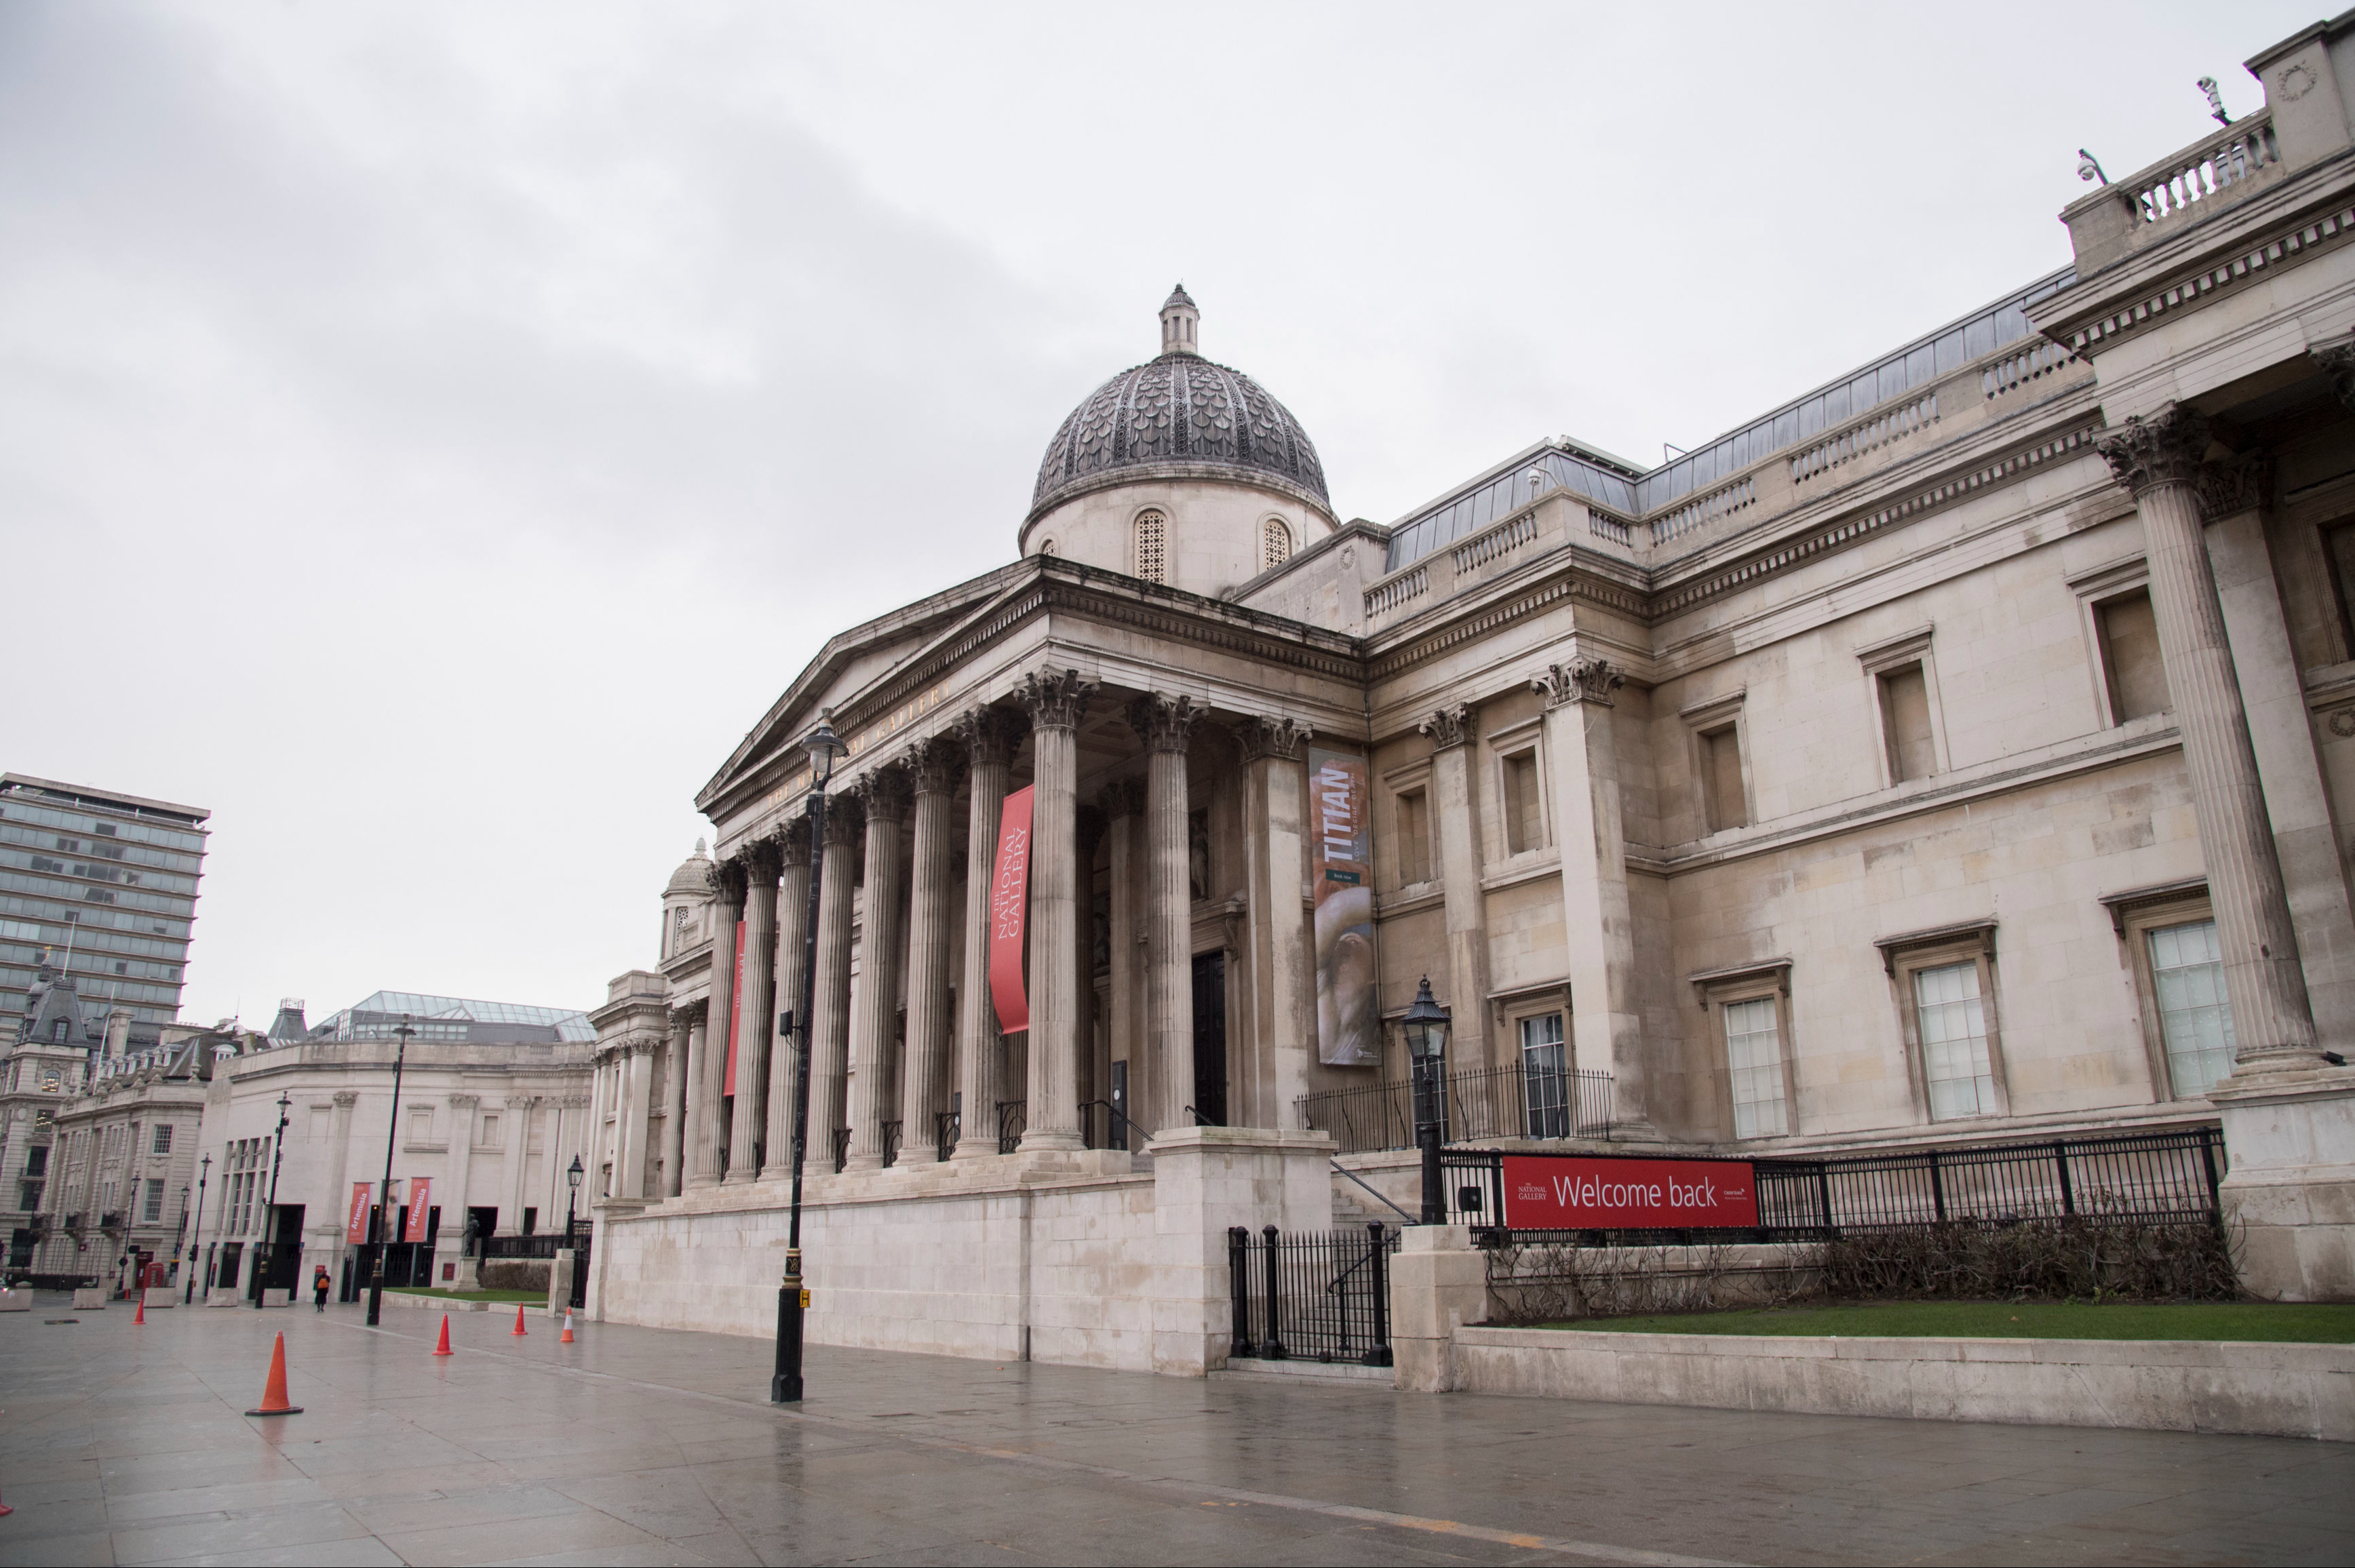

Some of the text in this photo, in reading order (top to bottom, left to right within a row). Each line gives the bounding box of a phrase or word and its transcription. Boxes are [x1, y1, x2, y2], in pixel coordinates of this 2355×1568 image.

[768, 783, 790, 810] THE
[877, 678, 953, 740] GALLERY
[1321, 767, 1352, 863] TITIAN
[998, 827, 1015, 941] NATIONAL
[1008, 827, 1026, 937] GALLERY
[351, 1193, 367, 1230] Artemisia
[409, 1188, 427, 1227] Artemisia
[1553, 1174, 1717, 1207] Welcome back
[801, 1291, 810, 1306] H
